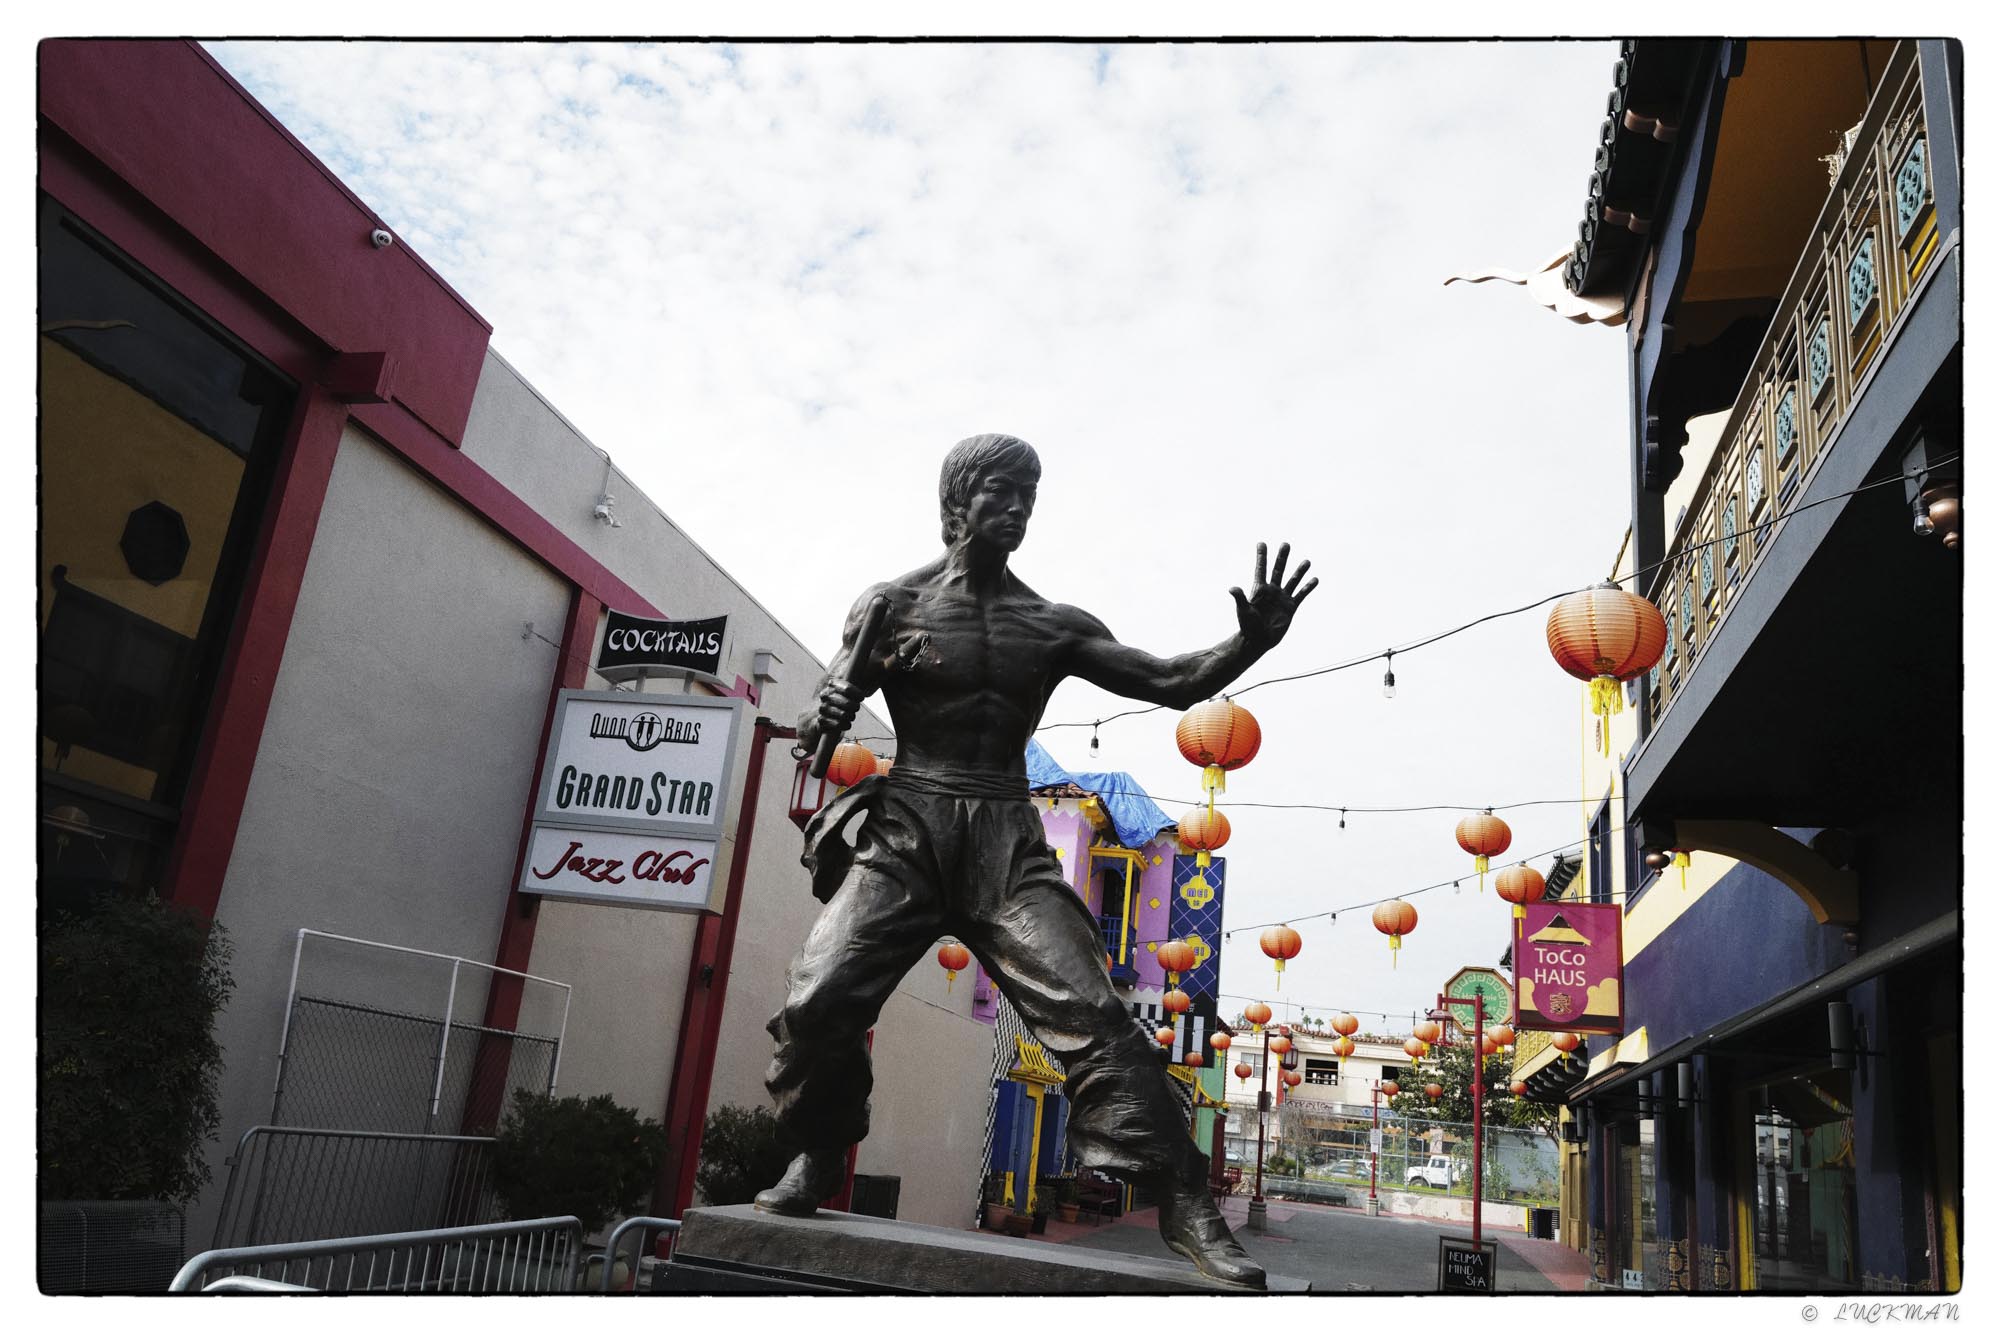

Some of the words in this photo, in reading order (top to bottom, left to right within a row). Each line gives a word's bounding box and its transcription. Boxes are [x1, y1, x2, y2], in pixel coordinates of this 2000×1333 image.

[607, 628, 720, 655] COCKTAILS
[664, 718, 701, 743] BROS
[556, 765, 644, 810] GRAND
[646, 771, 714, 816] STAR
[532, 842, 625, 884] Jazz
[632, 850, 710, 885] Club
[1534, 948, 1585, 966] ToCo
[1534, 968, 1586, 987] HAUS
[1448, 1264, 1474, 1275] MIND
